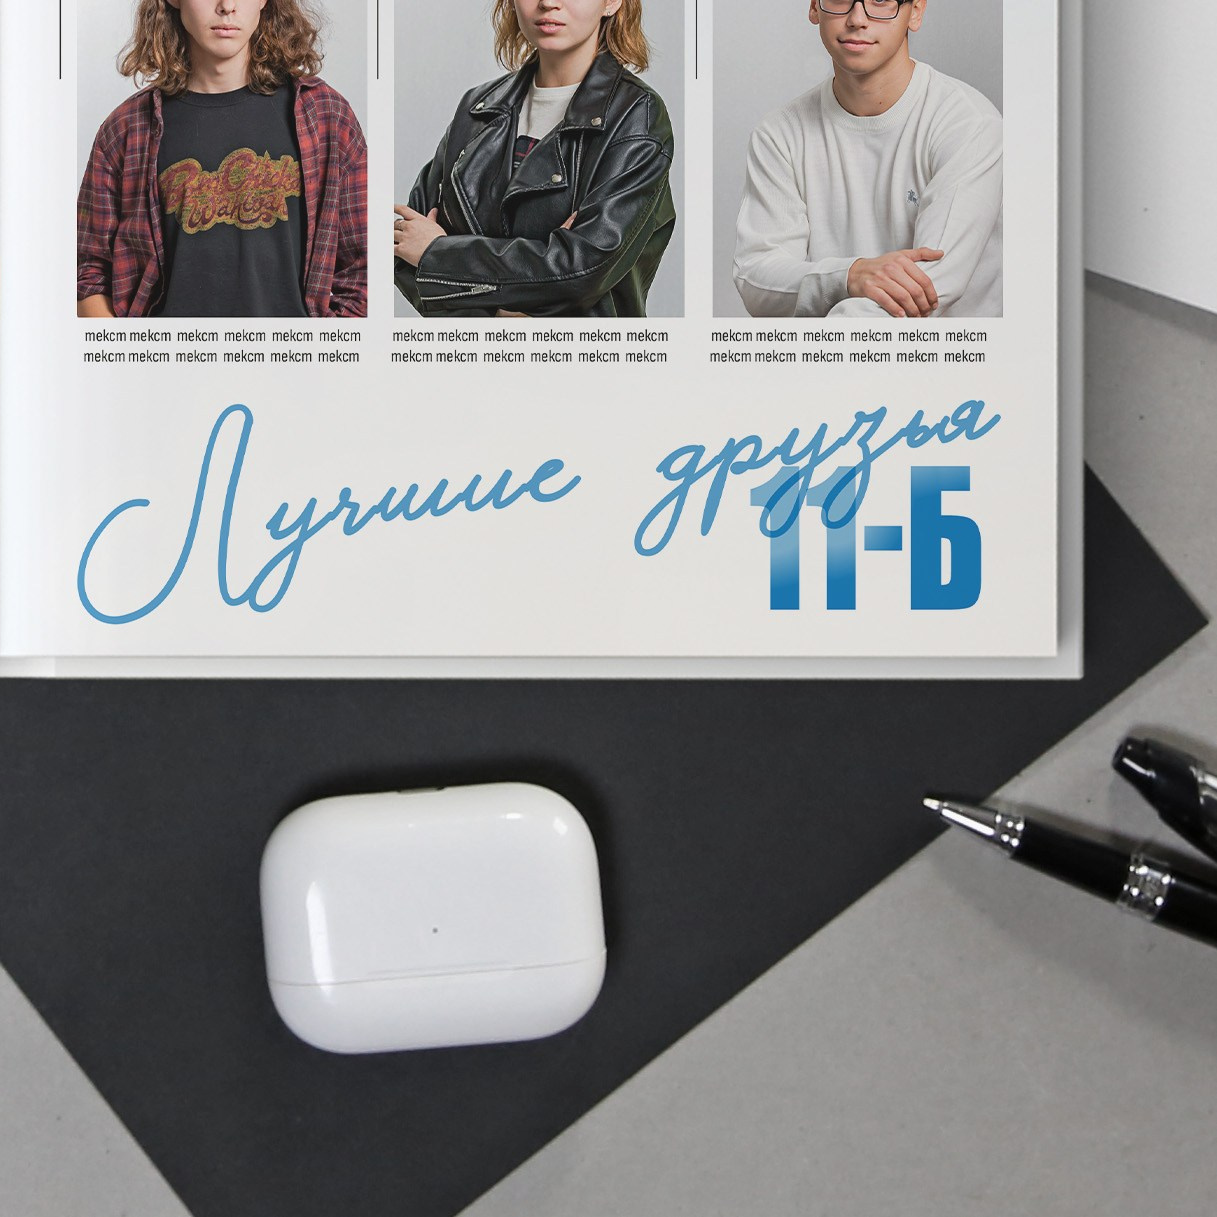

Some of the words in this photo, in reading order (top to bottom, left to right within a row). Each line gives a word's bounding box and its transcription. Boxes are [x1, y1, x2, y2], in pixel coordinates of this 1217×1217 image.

[77, 403, 581, 625] Лучшие
[634, 400, 1001, 556] друзья
[750, 466, 982, 610] 11-Б
